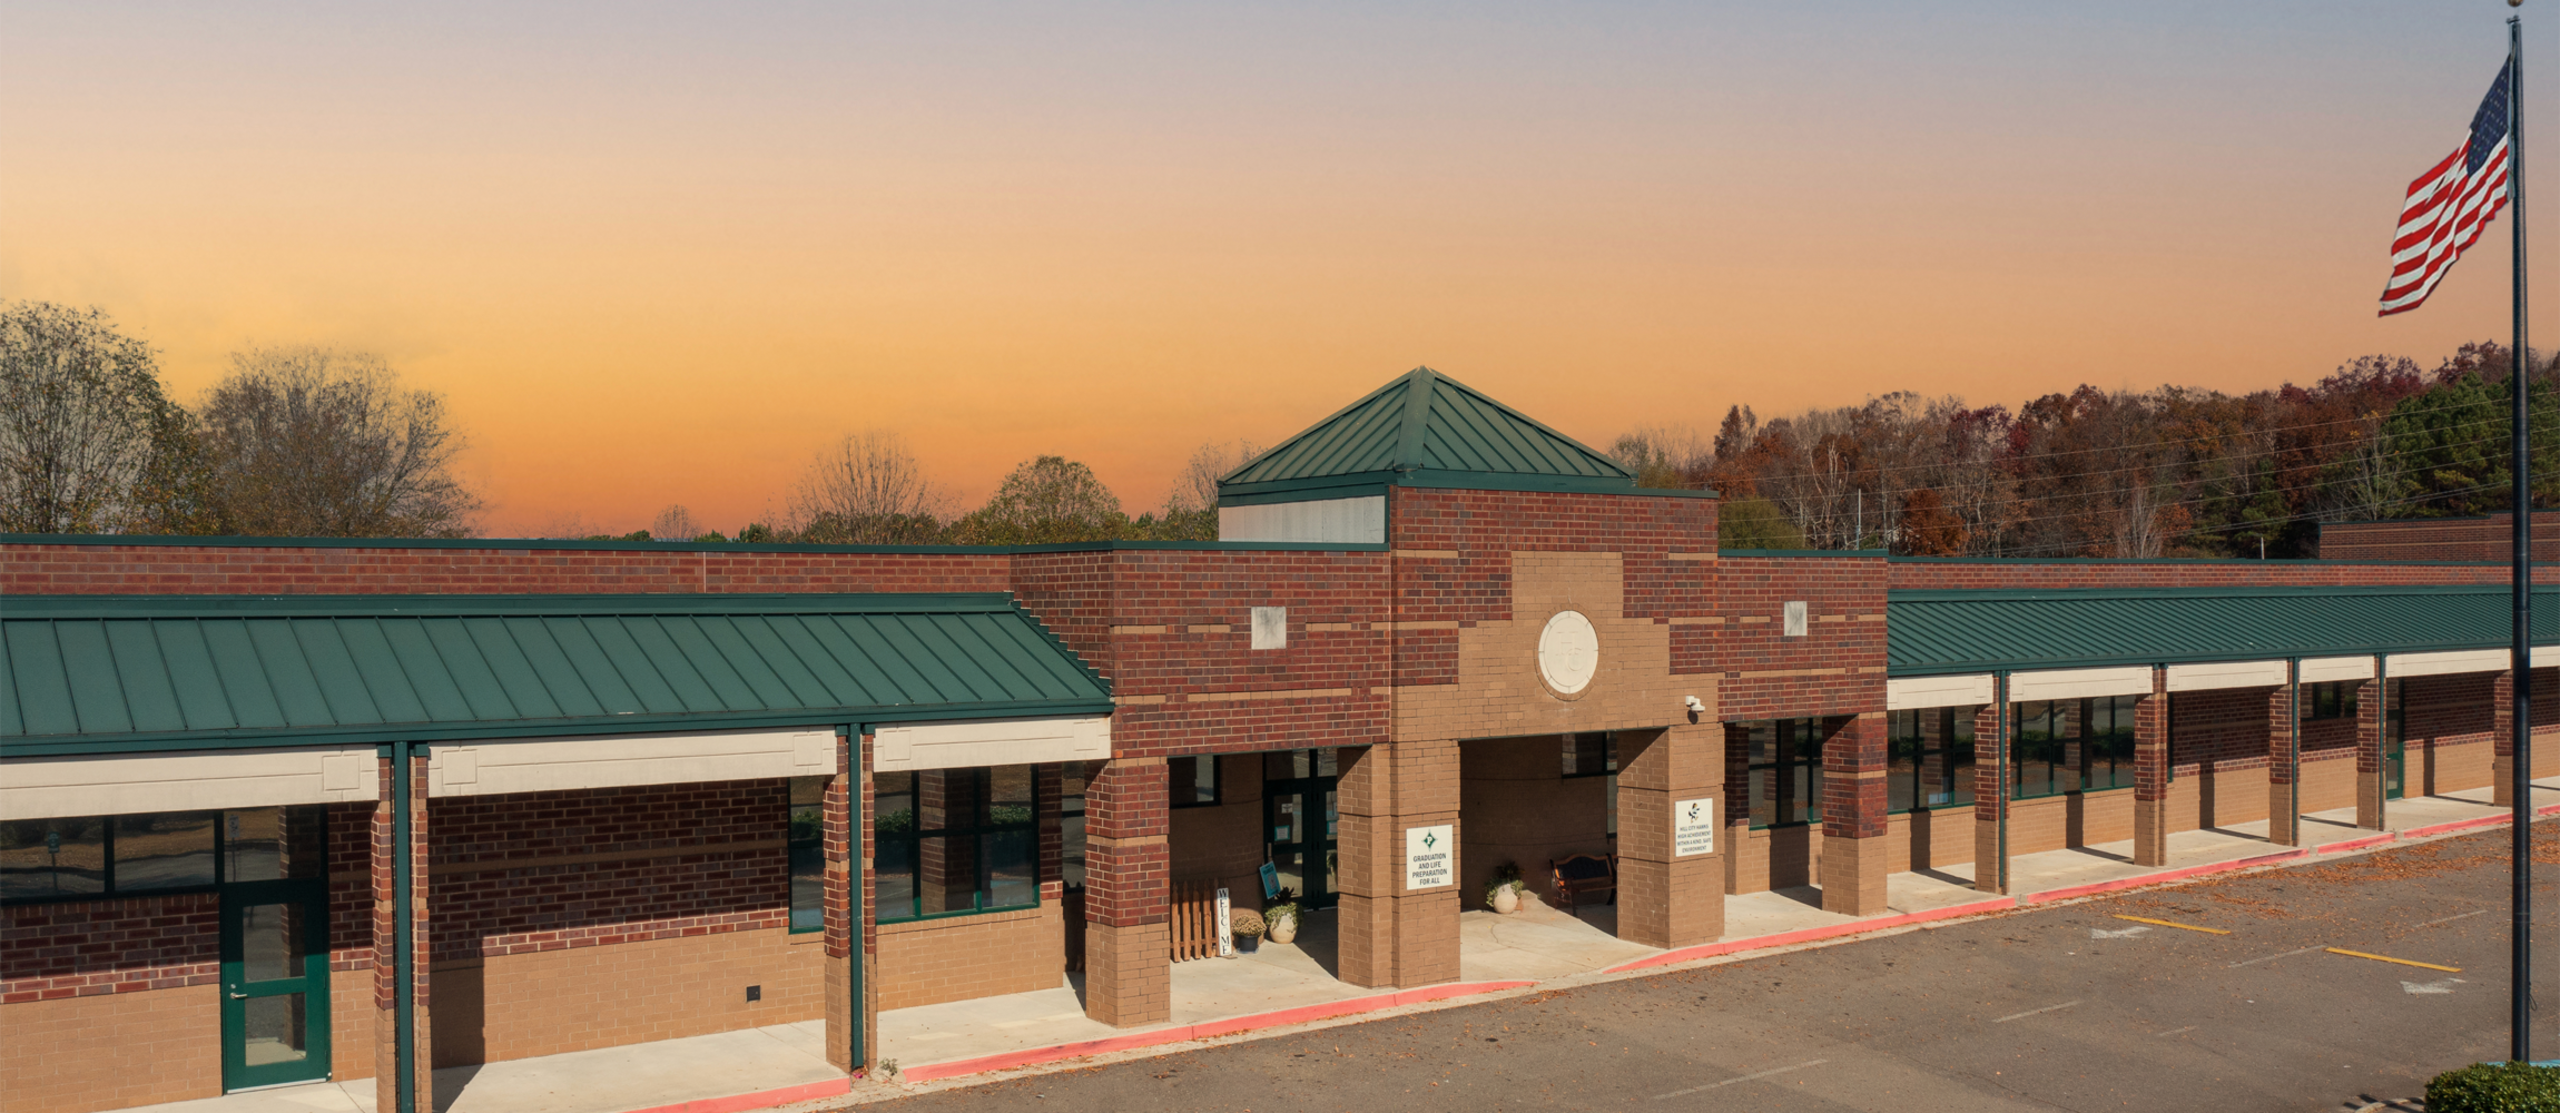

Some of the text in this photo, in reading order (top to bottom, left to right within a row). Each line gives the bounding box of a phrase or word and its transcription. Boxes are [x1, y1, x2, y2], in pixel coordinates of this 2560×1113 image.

[1413, 853, 1446, 862] GRADUATION
[1418, 862, 1430, 870] AND
[1412, 868, 1448, 878] PREPARATION
[1219, 889, 1230, 955] WELCOME
